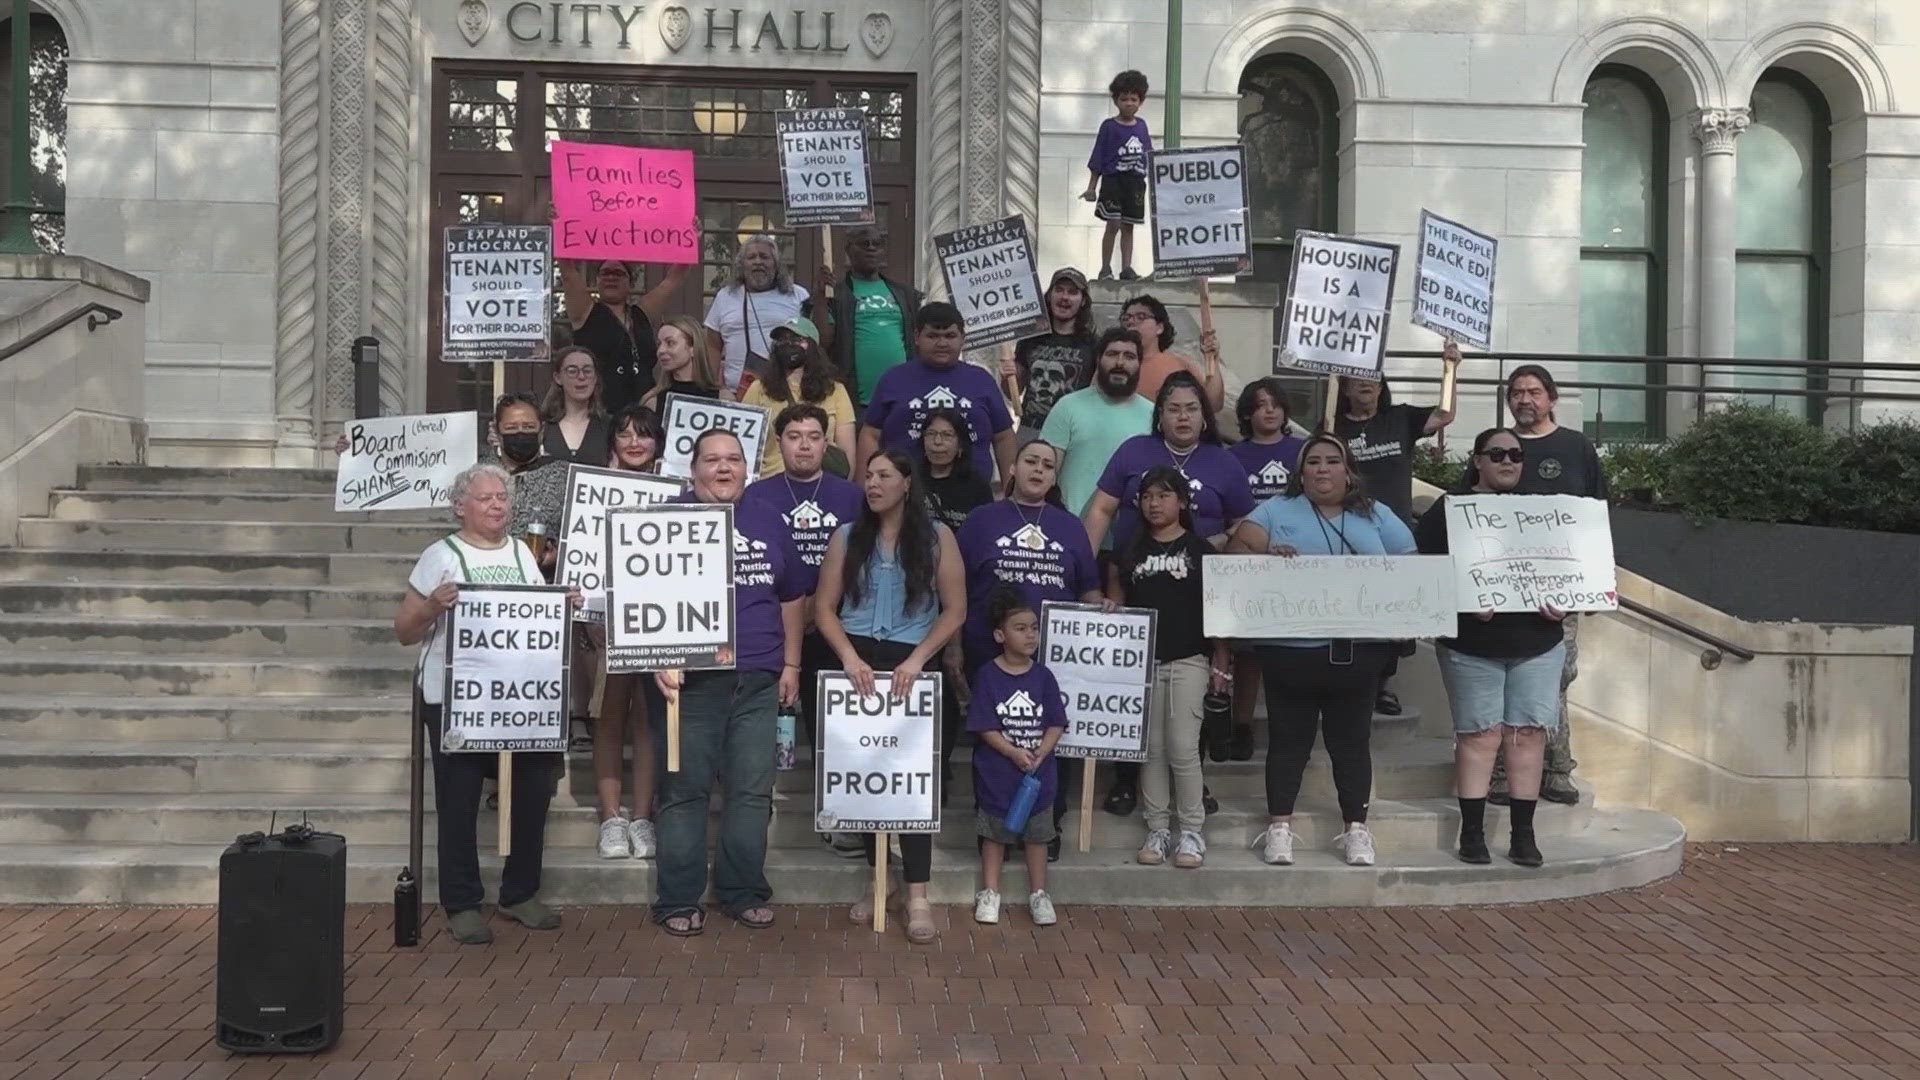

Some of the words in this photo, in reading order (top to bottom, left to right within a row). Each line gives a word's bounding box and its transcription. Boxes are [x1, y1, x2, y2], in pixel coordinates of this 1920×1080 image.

[506, 2, 645, 48] CITY
[703, 9, 850, 51] HALL
[795, 111, 846, 120] EXPAND
[785, 136, 862, 152] TENANTS
[804, 155, 847, 166] SHOULD
[566, 153, 683, 190] Families
[801, 171, 853, 188] VOTE
[1155, 159, 1240, 184] PUEBLO
[587, 189, 659, 212] Before
[791, 193, 809, 202] FOR
[811, 192, 834, 202] THEIR
[835, 191, 866, 201] BOARD
[1184, 193, 1216, 205] OVER
[467, 229, 528, 240] EXPAND
[563, 220, 695, 249] Evictions
[953, 221, 1005, 242] EXPAND
[1160, 223, 1243, 248] PROFIT
[1426, 223, 1449, 242] THE
[1451, 233, 1492, 260] PEOPLE
[451, 259, 543, 276] TENANTS
[947, 245, 1026, 277] TENANTS
[1300, 245, 1391, 274] HOUSING
[1426, 242, 1464, 270] BACK
[1468, 260, 1490, 280] ED!
[471, 281, 523, 292] SHOULD
[969, 268, 1012, 287] SHOULD
[1323, 277, 1341, 294] IS
[1348, 280, 1361, 297] A
[968, 284, 1023, 310] VOTE
[1421, 277, 1440, 295] ED
[1444, 285, 1488, 315] BACKS
[466, 299, 528, 318] VOTE
[982, 310, 1005, 323] THEIR
[1006, 301, 1039, 317] BOARD
[1293, 304, 1380, 334] HUMAN
[1420, 299, 1440, 316] THE
[1442, 307, 1488, 335] PEOPLE!
[452, 323, 473, 335] FOR
[475, 323, 502, 334] THEIR
[504, 323, 542, 334] BOARD
[1298, 326, 1372, 355] RIGHT
[674, 408, 757, 439] LOPEZ
[351, 424, 407, 457] Board
[373, 447, 447, 474] Commision
[342, 470, 408, 505] SHAME
[413, 478, 430, 493] on
[575, 483, 625, 506] END
[1454, 502, 1507, 529] The
[620, 521, 720, 546] LOPEZ
[567, 549, 598, 567] ON
[1002, 549, 1044, 559] Coalition
[1045, 552, 1059, 560] for
[1475, 536, 1572, 559] Demand
[625, 553, 703, 577] OUT!
[996, 559, 1030, 569] Tenant
[1031, 561, 1065, 573] Justice
[1468, 568, 1585, 587] Reinstatement
[458, 601, 492, 618] THE
[497, 603, 562, 620] PEOPLE
[1478, 592, 1507, 609] ED
[623, 603, 667, 634] ED
[677, 601, 720, 632] IN!
[458, 628, 520, 650] BACK
[526, 630, 560, 650] ED!
[1050, 619, 1081, 636] THE
[1085, 622, 1146, 640] PEOPLE
[607, 647, 650, 656] OPPRESSED
[608, 659, 624, 667] FOR
[625, 658, 657, 667] WORKER
[658, 657, 686, 666] POWER
[1050, 644, 1105, 667] BACK
[1112, 648, 1144, 669] ED!
[453, 680, 483, 700] ED
[491, 680, 561, 700] BACKS
[826, 689, 933, 717] PEOPLE
[1076, 693, 1143, 714] BACKS
[451, 711, 485, 728] THE
[490, 711, 560, 728] PEOPLE!
[1076, 721, 1142, 739] PEOPLE!
[466, 740, 505, 750] PUEBLO
[507, 740, 532, 749] OVER
[534, 739, 568, 749] PROFIT
[859, 735, 899, 748] OVER
[1090, 749, 1114, 758] OVER
[1115, 751, 1147, 760] PROFIT
[826, 771, 931, 795] PROFIT
[839, 820, 876, 830] PUEBLO
[878, 820, 904, 830] OVER
[906, 821, 939, 830] PROFIT
